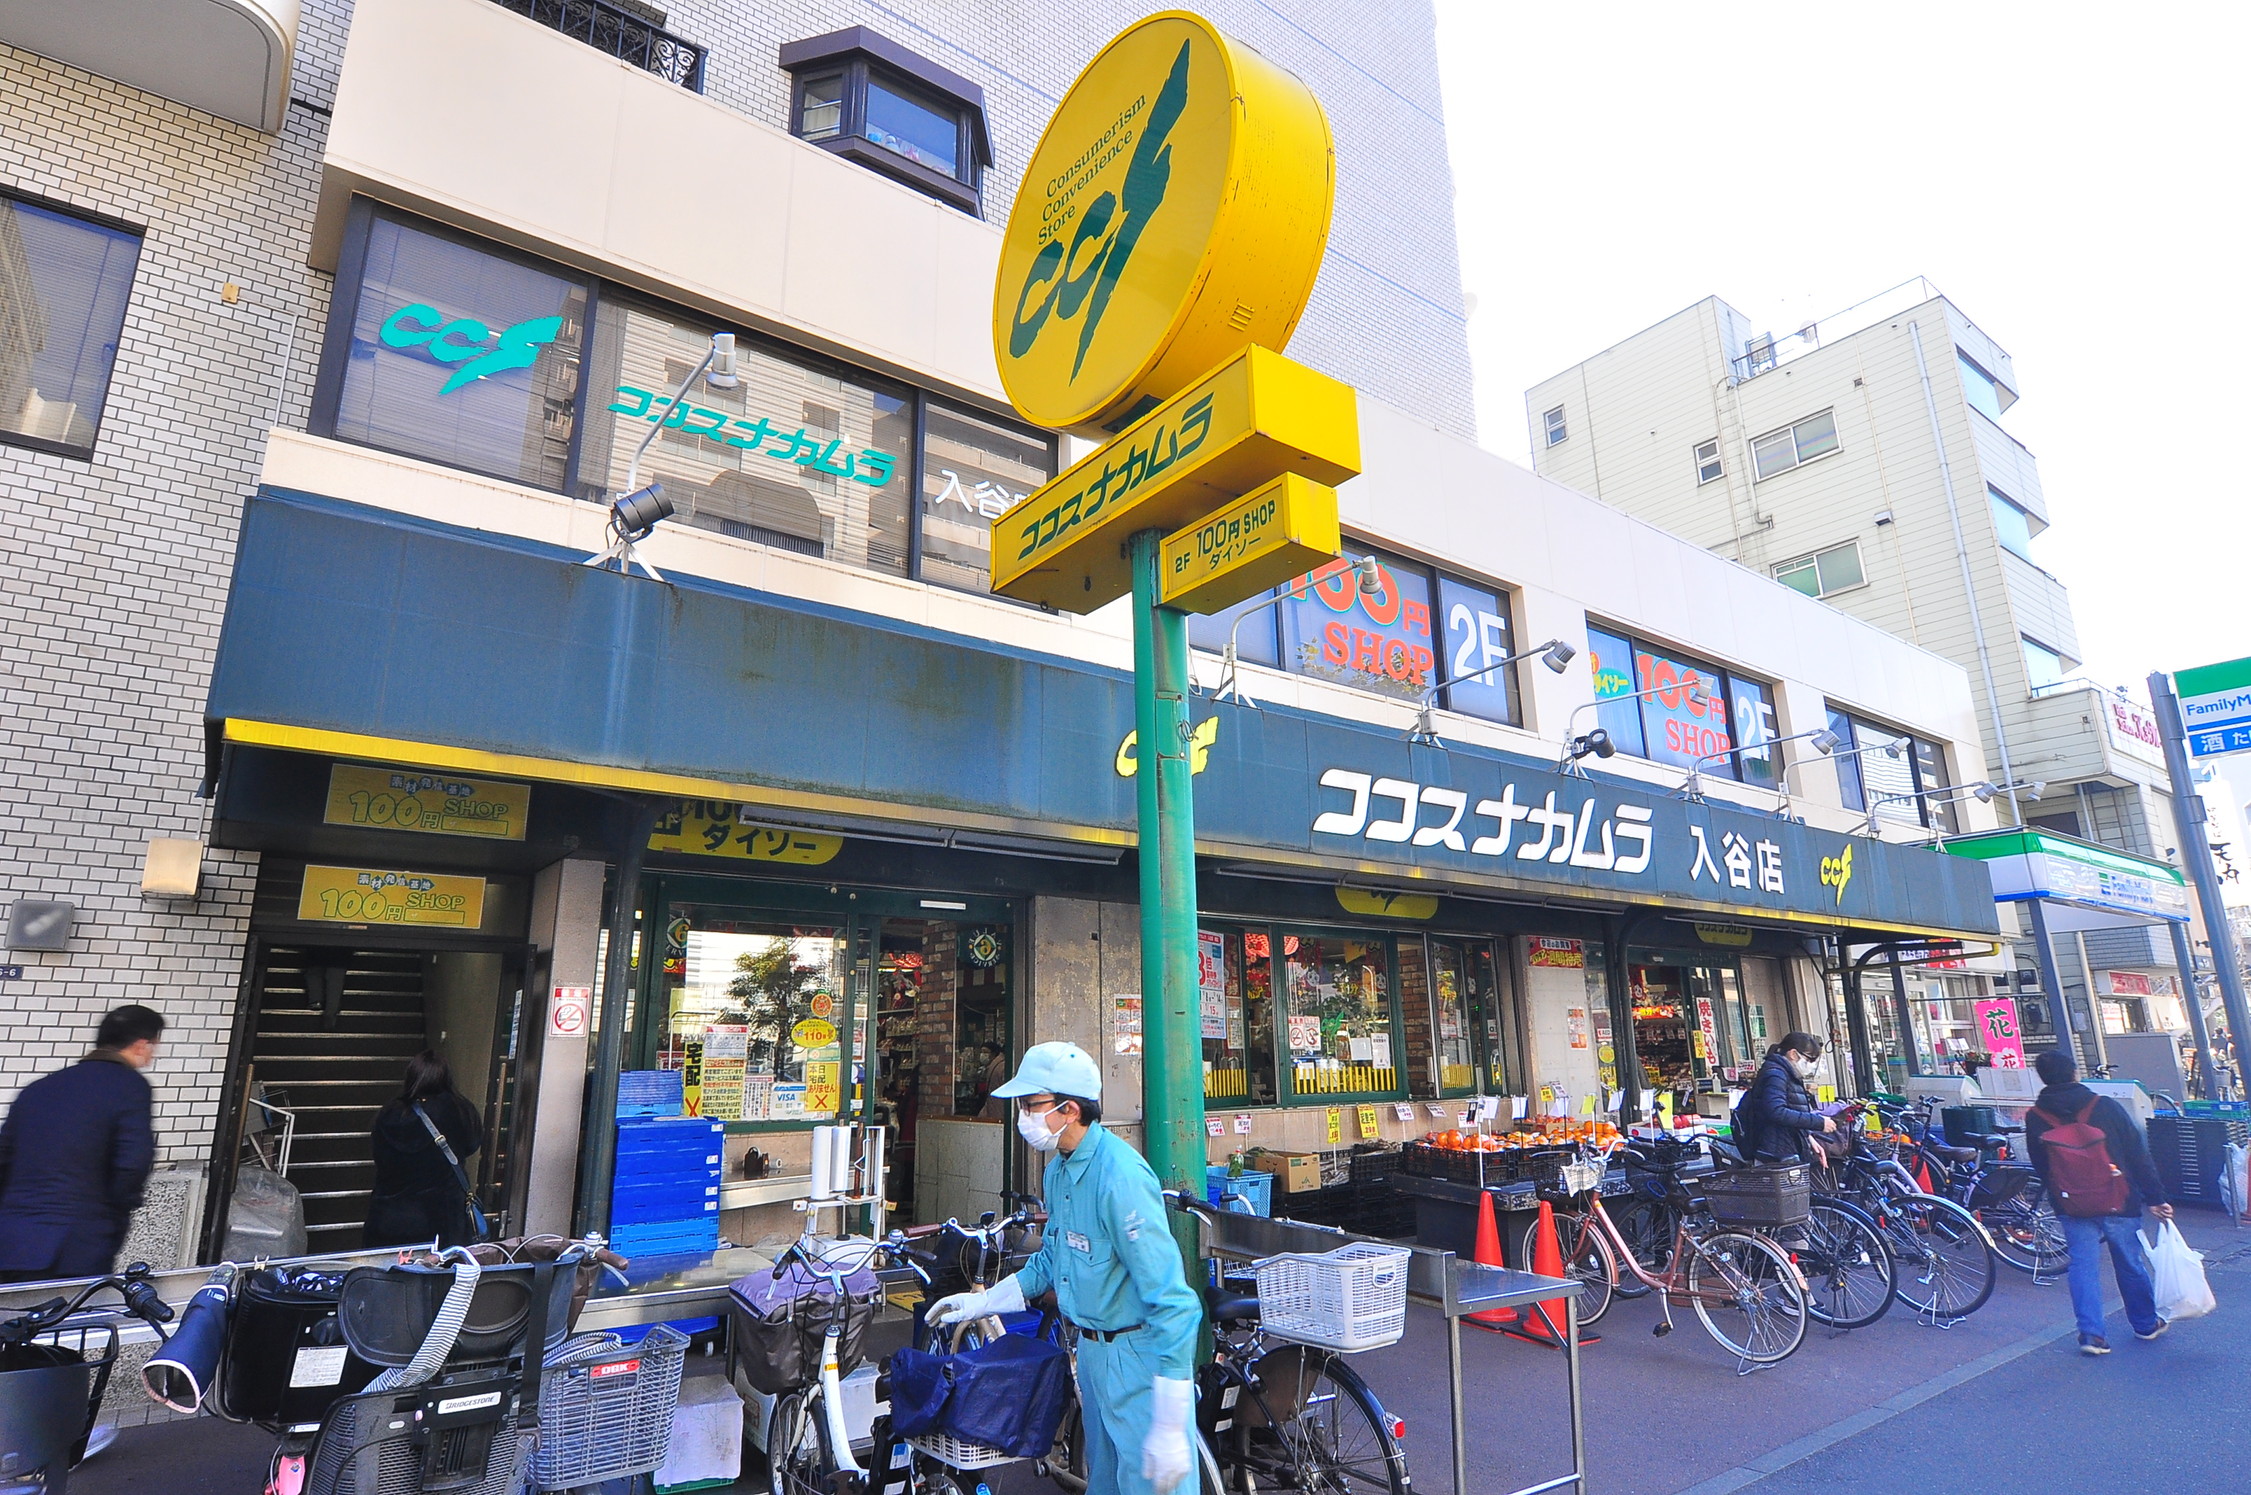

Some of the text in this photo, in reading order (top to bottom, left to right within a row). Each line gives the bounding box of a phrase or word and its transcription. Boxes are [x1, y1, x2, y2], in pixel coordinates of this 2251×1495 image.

[1045, 93, 1146, 198] Consumerism
[1042, 130, 1133, 221] Convenience
[1038, 205, 1076, 245] Store
[607, 386, 897, 487] ココスナカムラ
[1017, 391, 1215, 561] ココスナカムラ
[1175, 499, 1276, 574] 2F 100円 SHOP
[1209, 535, 1262, 571] ダイソー
[1323, 621, 1434, 686] SHOP
[1449, 602, 1508, 687] 2F
[1636, 652, 1726, 726] 100円
[1665, 718, 1731, 764] SHOP
[1737, 695, 1776, 763] 2F
[2200, 732, 2251, 752] 酒 た
[350, 790, 509, 830] 100円 SHOP
[1313, 768, 1654, 874] ココスナカムラ
[702, 824, 816, 856] ダイソー
[1689, 824, 1785, 895] 入谷店
[320, 888, 465, 922] 100円 SHOP
[1698, 999, 1717, 1065] 焼きいも
[1985, 1008, 2015, 1040] 花
[685, 1042, 702, 1087] 宅配
[809, 1064, 826, 1075] 本日
[777, 1093, 796, 1102] VISA
[808, 1083, 836, 1094] ありません
[445, 1395, 496, 1410] BRIDGESTONE
